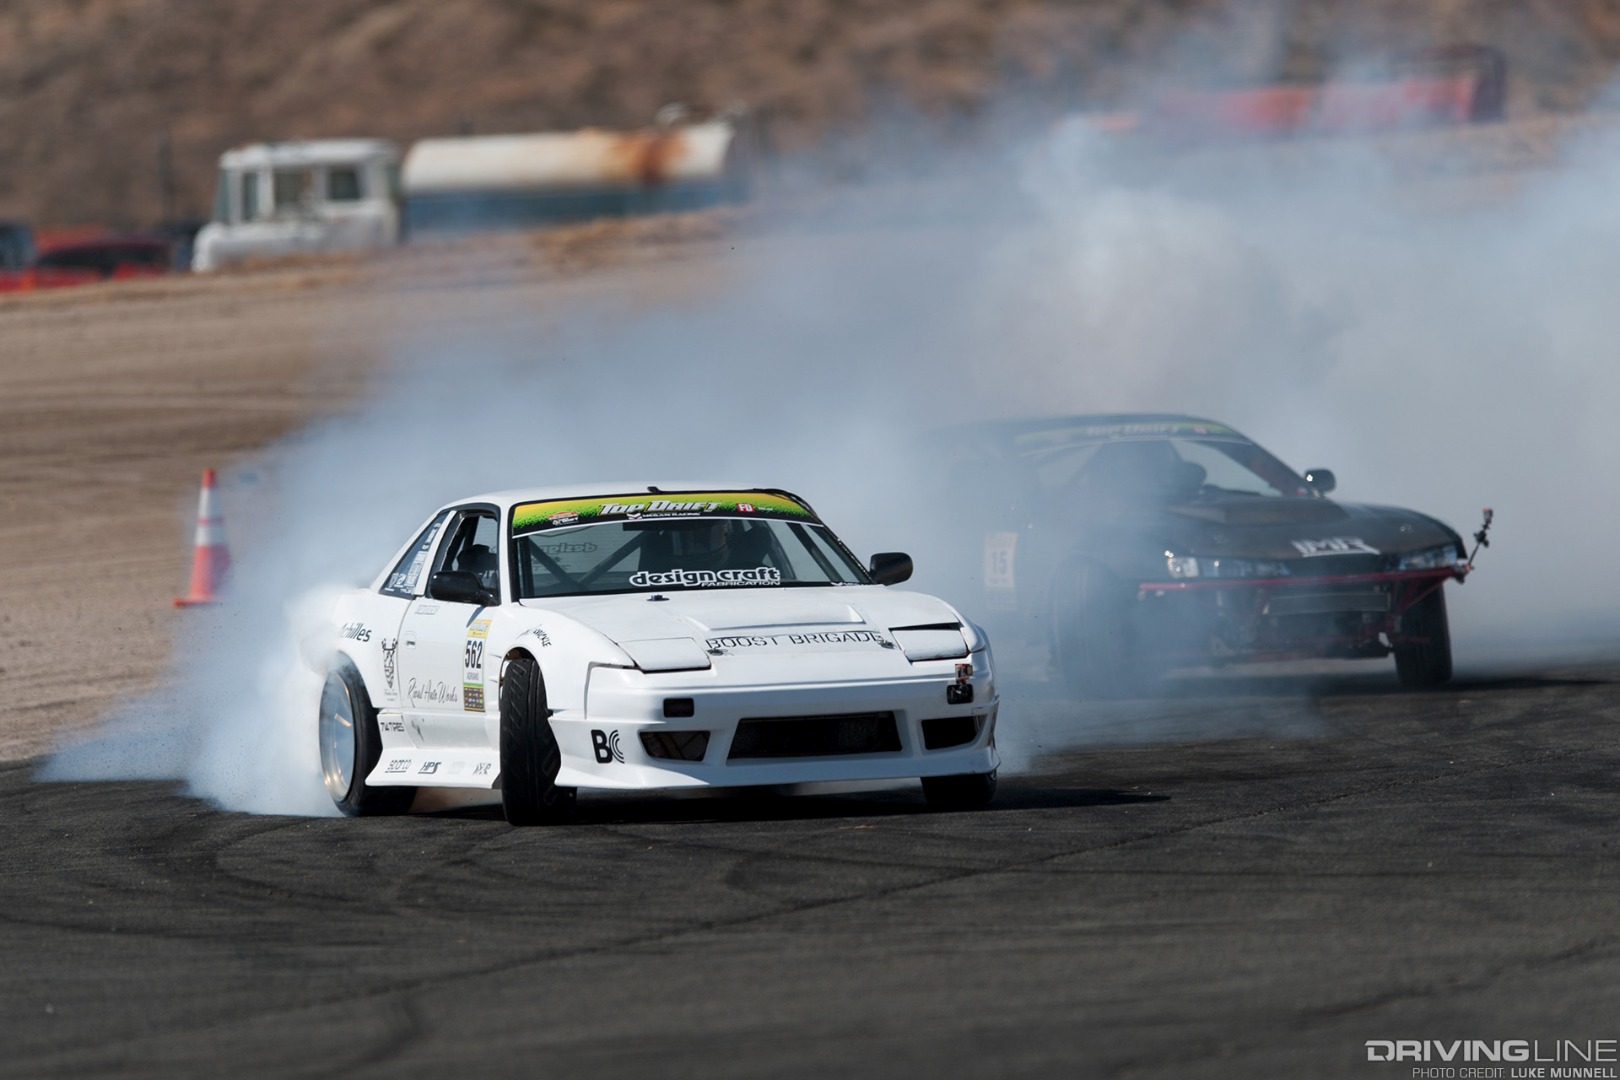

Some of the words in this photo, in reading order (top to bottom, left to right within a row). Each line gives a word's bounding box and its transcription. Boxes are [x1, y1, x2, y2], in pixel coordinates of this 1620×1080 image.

[991, 550, 1007, 575] 15
[705, 635, 779, 650] BOOST
[789, 631, 884, 645] BRIGADE
[465, 640, 483, 669] 562
[418, 762, 442, 775] HPS
